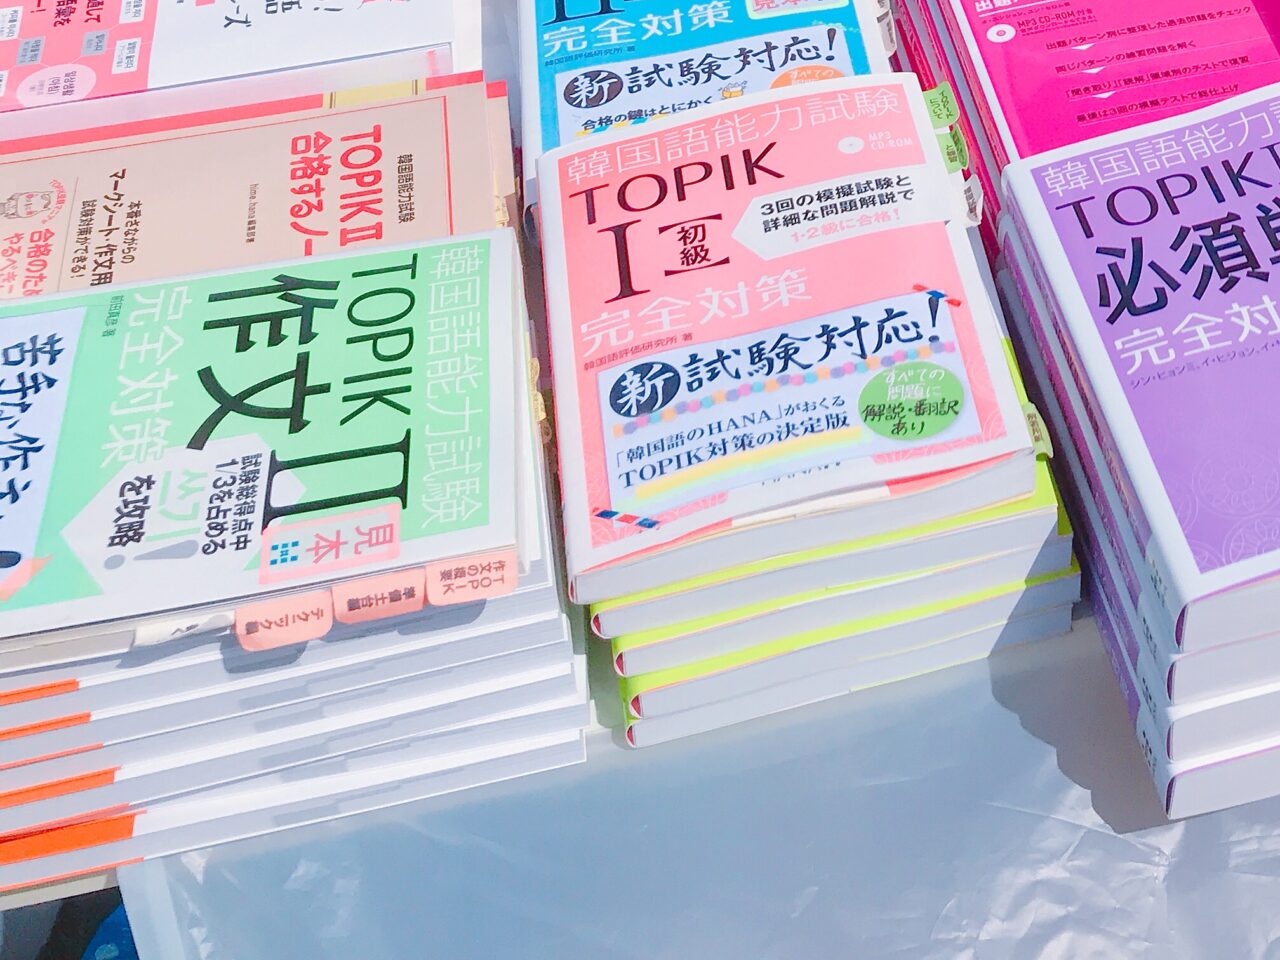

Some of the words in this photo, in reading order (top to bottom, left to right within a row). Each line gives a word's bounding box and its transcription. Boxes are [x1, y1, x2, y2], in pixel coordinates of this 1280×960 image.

[542, 0, 734, 58] 完全対策
[567, 88, 902, 186] 韓国語能力試験
[581, 96, 714, 131] 合格の鍵はとにかく
[395, 153, 417, 224] 韓国語能力試験
[568, 141, 786, 225] TOPIK
[760, 173, 913, 217] 3回の模擬試験と
[762, 188, 916, 234] 詳細な問題解説で
[339, 252, 420, 427] TOPIK
[581, 269, 812, 358] 完全対策
[99, 284, 192, 470] 完全対策
[185, 273, 342, 451] 作文
[421, 243, 484, 530] 韓国語能力試験
[615, 394, 847, 469] 「韓国語のHANA」がおくる
[618, 410, 851, 489] TOPIK対策の決定版
[200, 459, 239, 557] 1/3を占める
[228, 451, 265, 552] 試験総得点中
[305, 523, 395, 564] 見本
